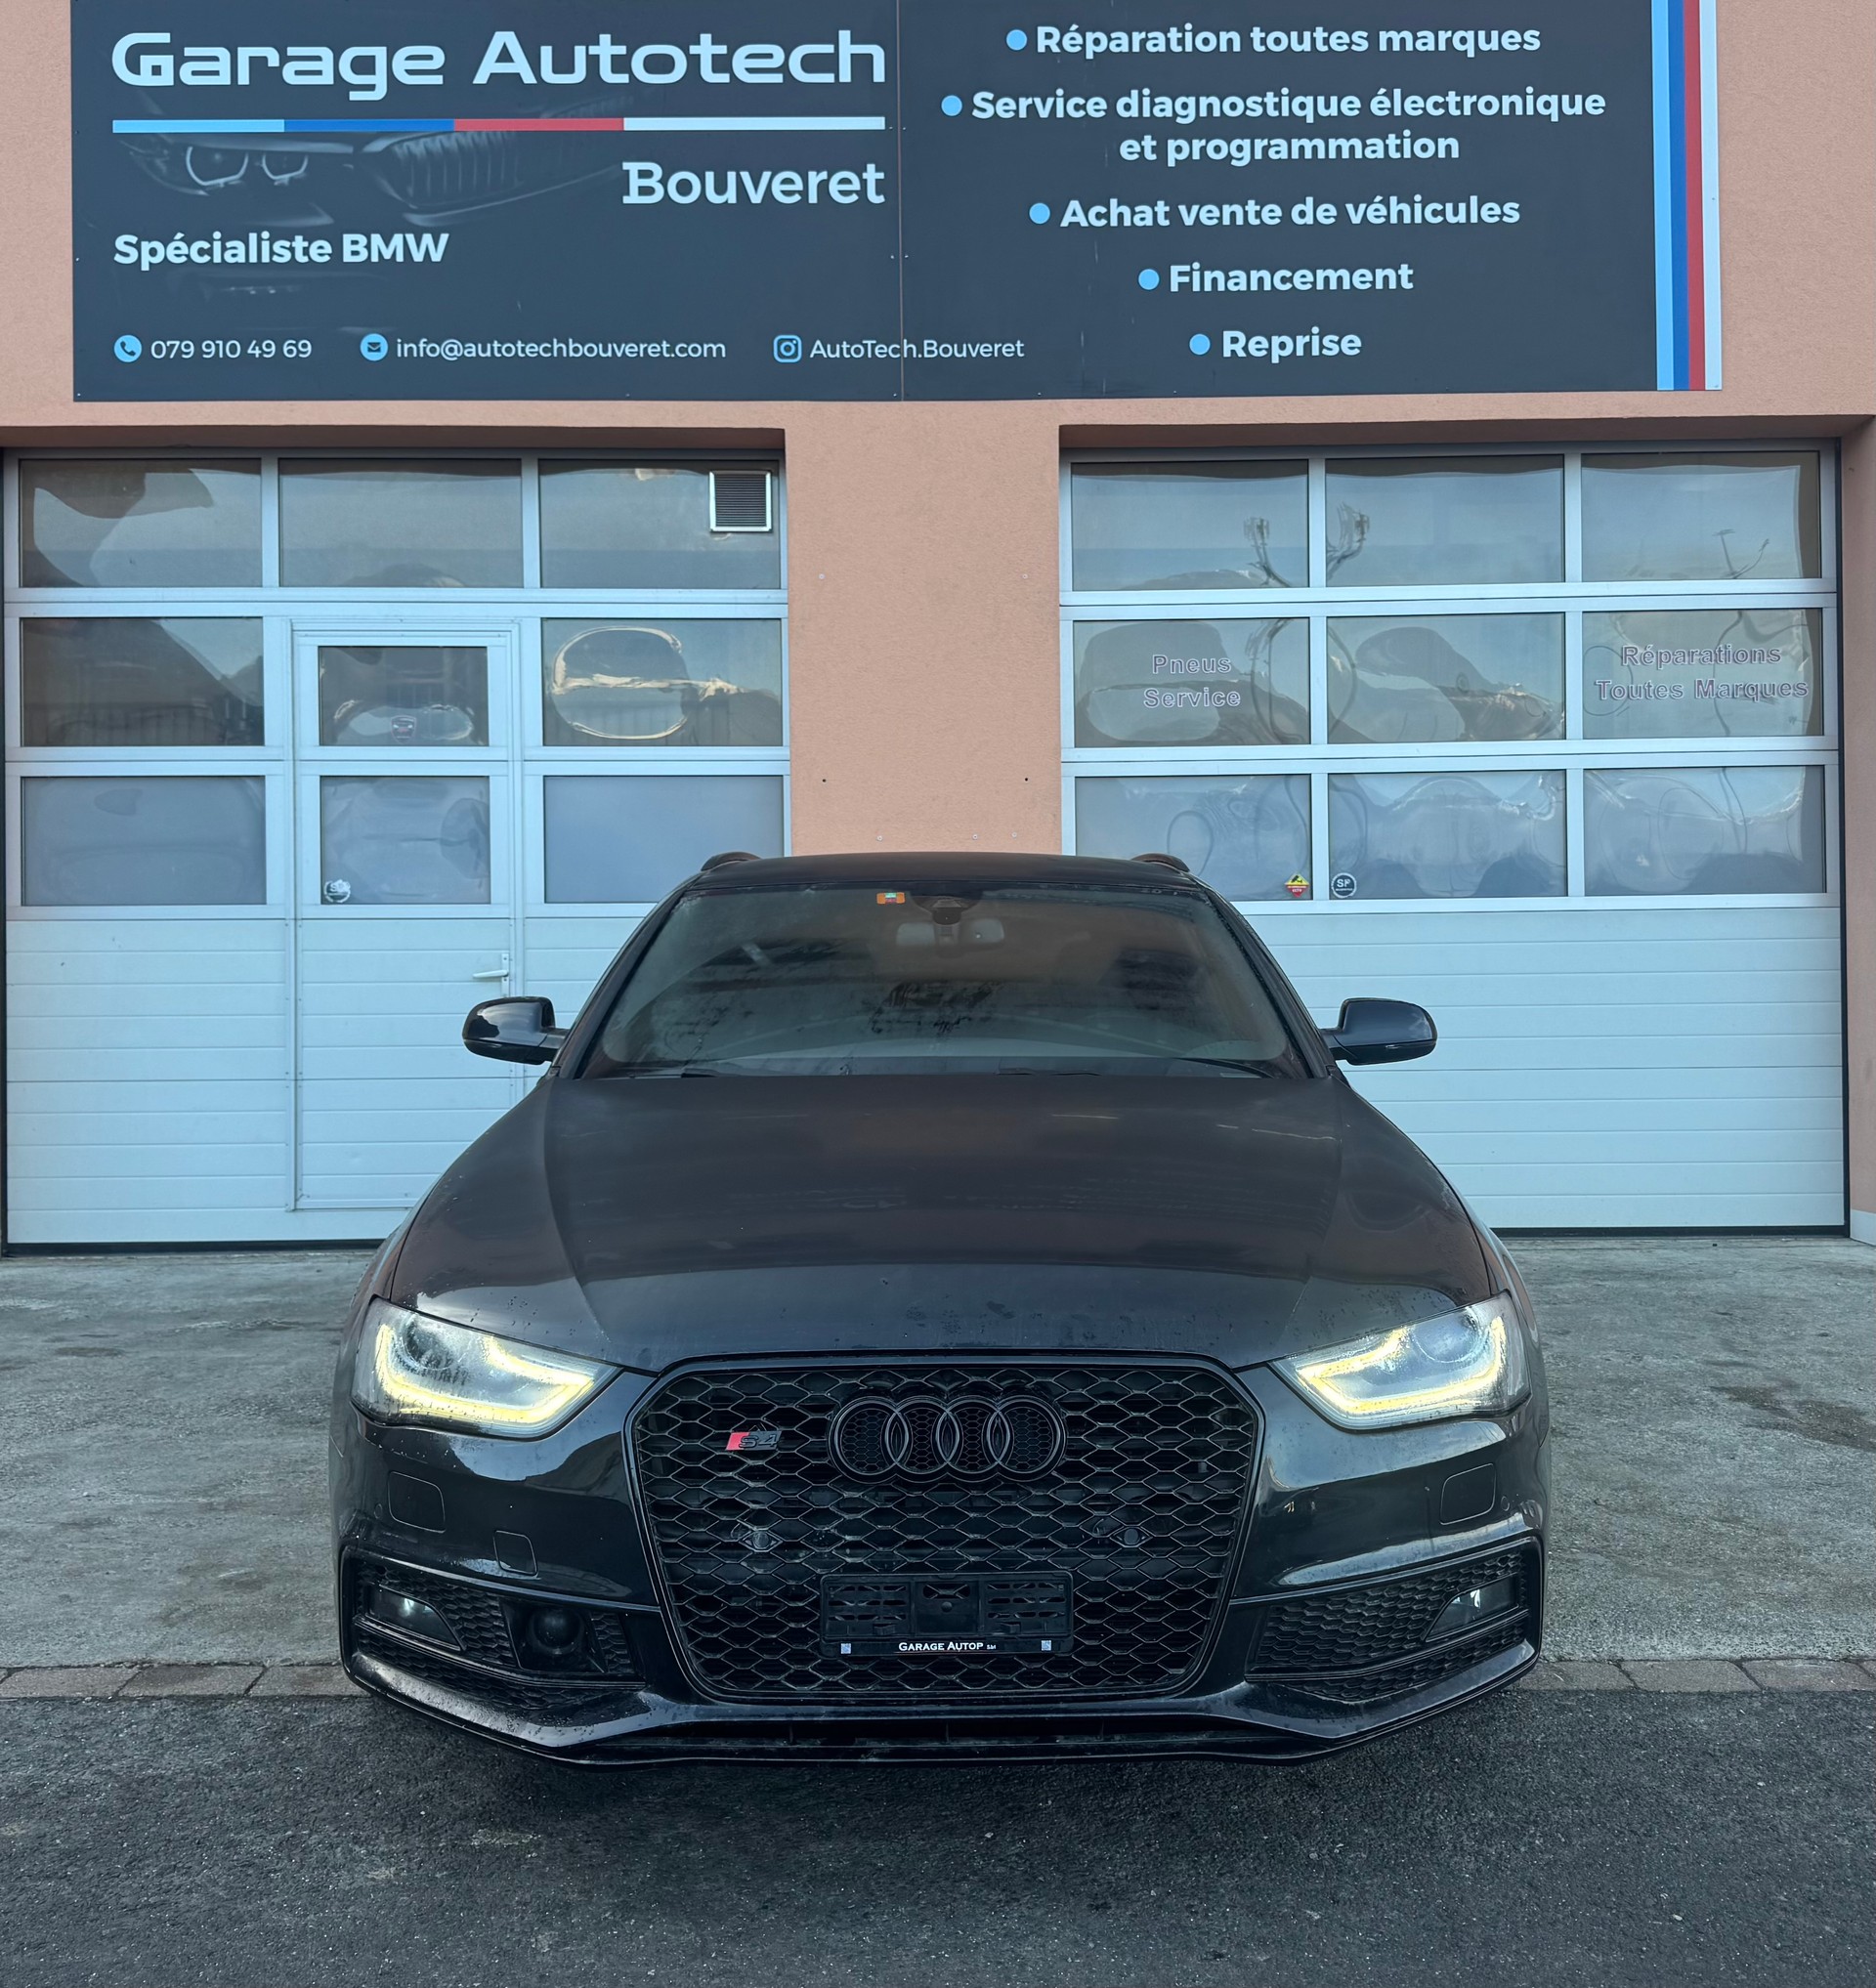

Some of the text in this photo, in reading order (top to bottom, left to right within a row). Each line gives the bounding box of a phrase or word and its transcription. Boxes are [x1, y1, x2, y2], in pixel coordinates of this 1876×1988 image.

[1036, 21, 1542, 61] Réparation toutes marques
[111, 28, 886, 103] Garage Autotech
[970, 84, 1607, 125] Service diagnostique électronique
[1118, 129, 1461, 168] et programmation
[620, 160, 886, 205] Bouveret
[1058, 191, 1521, 229] Achat vente de véhicules
[112, 229, 450, 273] Spécialiste BMW
[1169, 260, 1415, 293] Financement
[149, 338, 313, 360] 079 910 49 69
[396, 337, 727, 361] info@autotechbouveret.com
[809, 338, 1026, 360] AutoTech.Bouveret
[1221, 325, 1363, 364] Reprise
[1152, 654, 1232, 675] Pneus
[1621, 644, 1783, 670] Réparations
[1143, 687, 1242, 709] Service
[1595, 678, 1810, 702] Toutes Marques
[738, 1433, 779, 1449] S4
[898, 1641, 945, 1652] GARAGE
[946, 1641, 984, 1652] AUTOP
